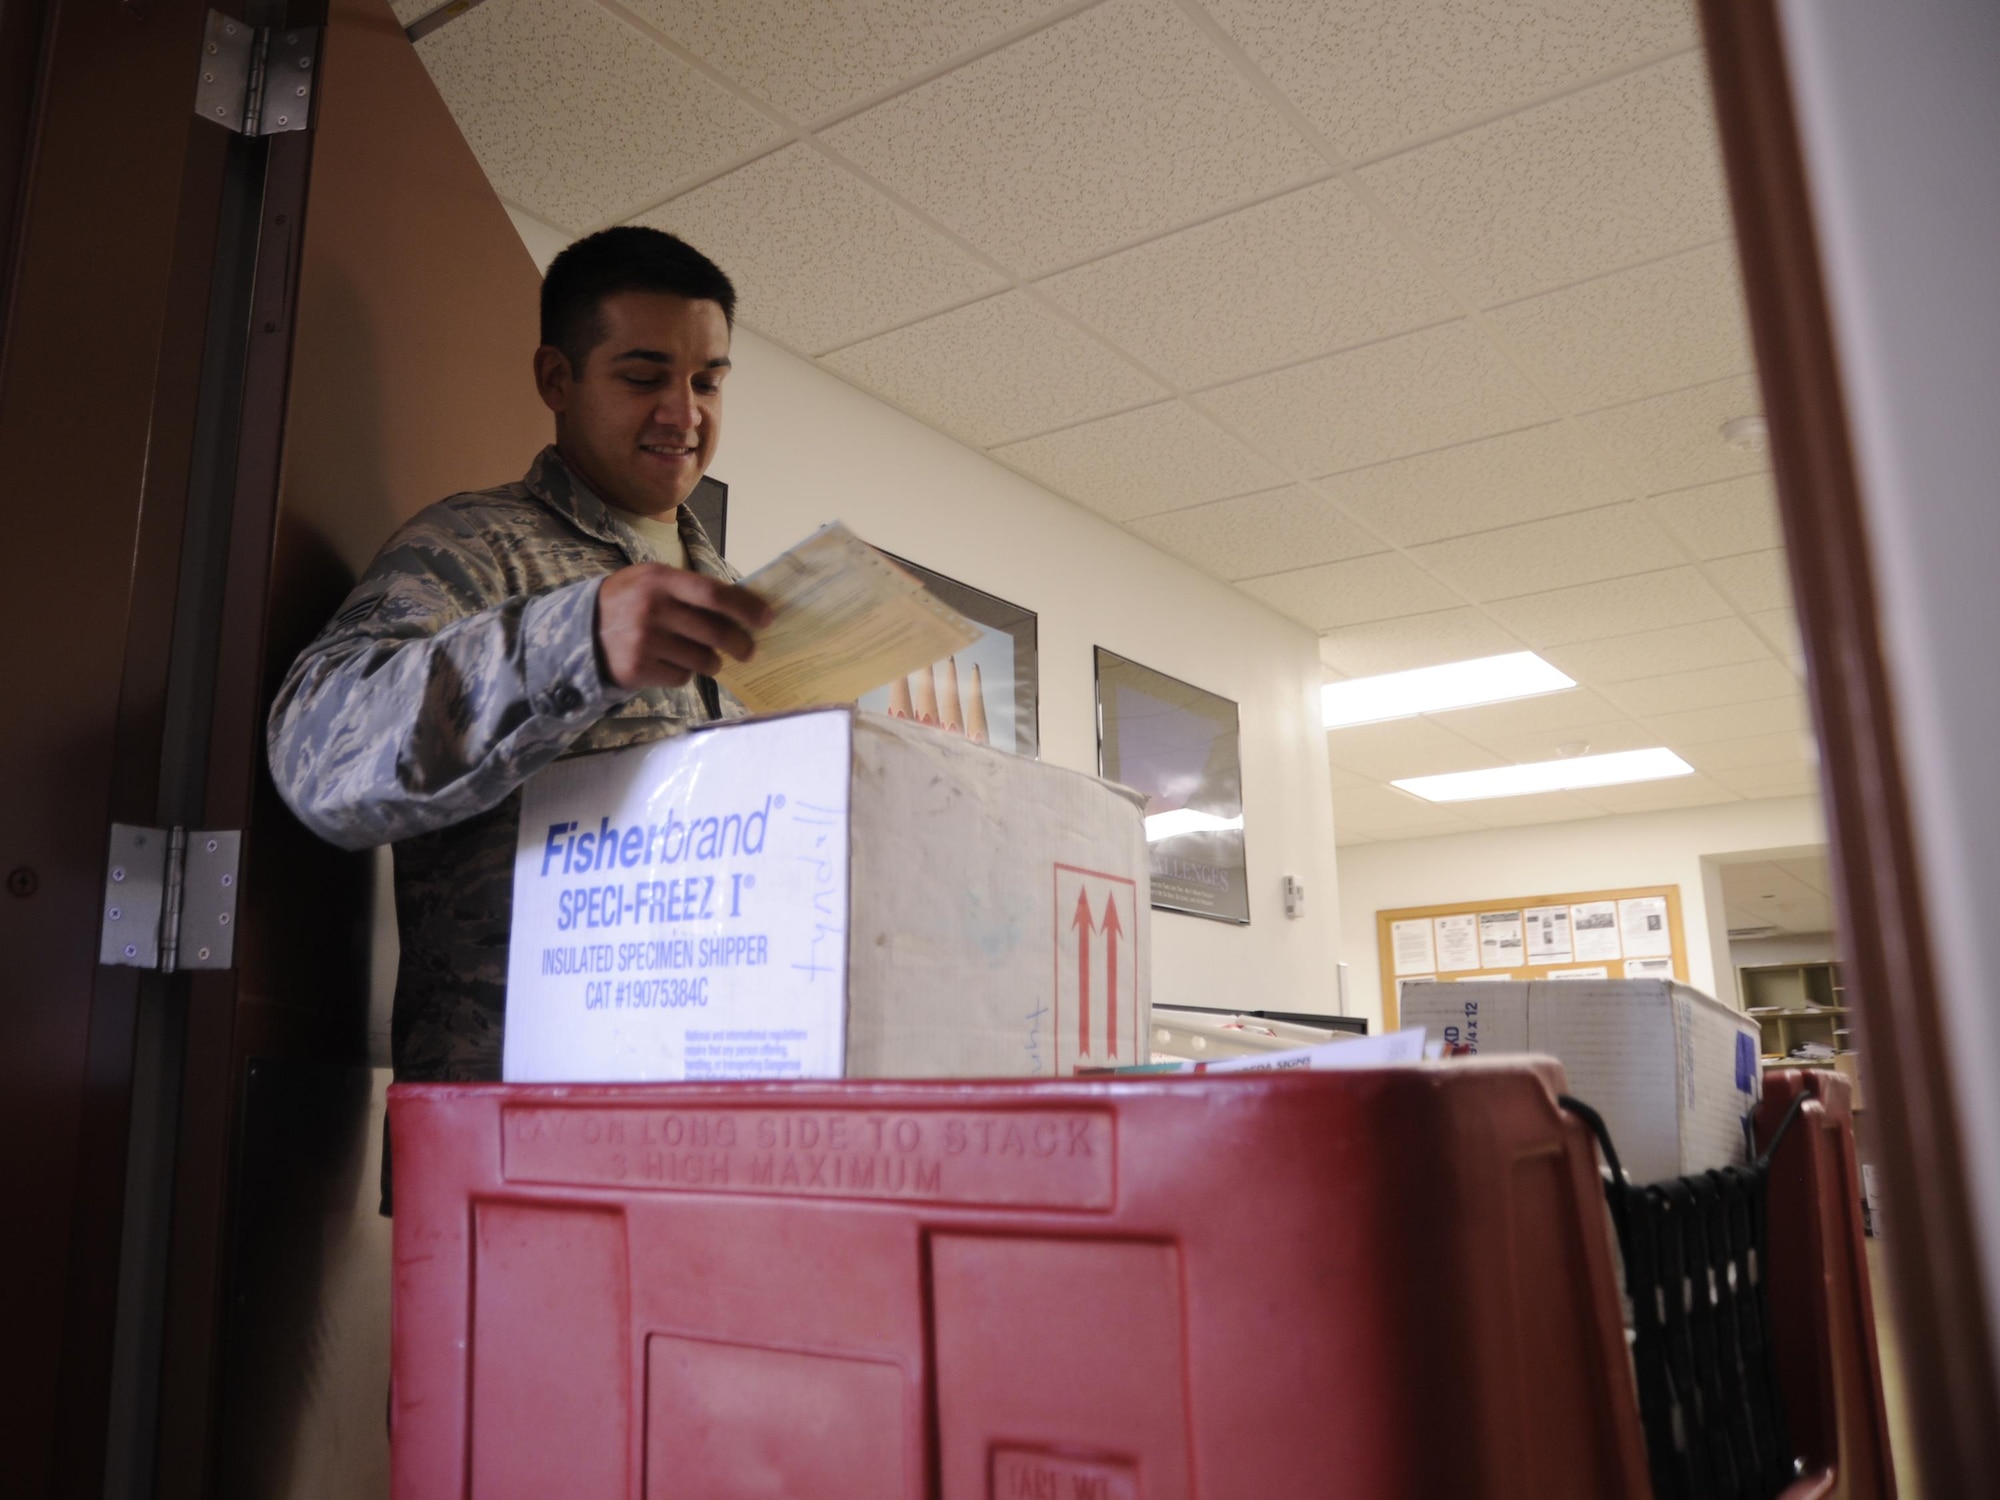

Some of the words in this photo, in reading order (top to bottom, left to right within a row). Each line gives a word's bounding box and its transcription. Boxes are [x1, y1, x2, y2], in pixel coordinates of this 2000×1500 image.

[557, 876, 716, 931] SPECI-FREEZ
[541, 944, 613, 976] INSULATED
[617, 939, 693, 972] SPECIMEN
[698, 935, 768, 968] SHIPPER
[585, 981, 611, 1010] CAT
[615, 976, 708, 1008] #19075384C
[1465, 1002, 1478, 1018] 12
[515, 1114, 567, 1143] LAY
[582, 1115, 625, 1145] ON
[642, 1115, 737, 1147] LONG
[757, 1116, 849, 1150] SIDE
[867, 1117, 921, 1152] TO
[944, 1118, 1093, 1158] STACK
[607, 1153, 626, 1180] 3
[645, 1152, 730, 1183] HIGH
[751, 1153, 941, 1194] MAXIMUM
